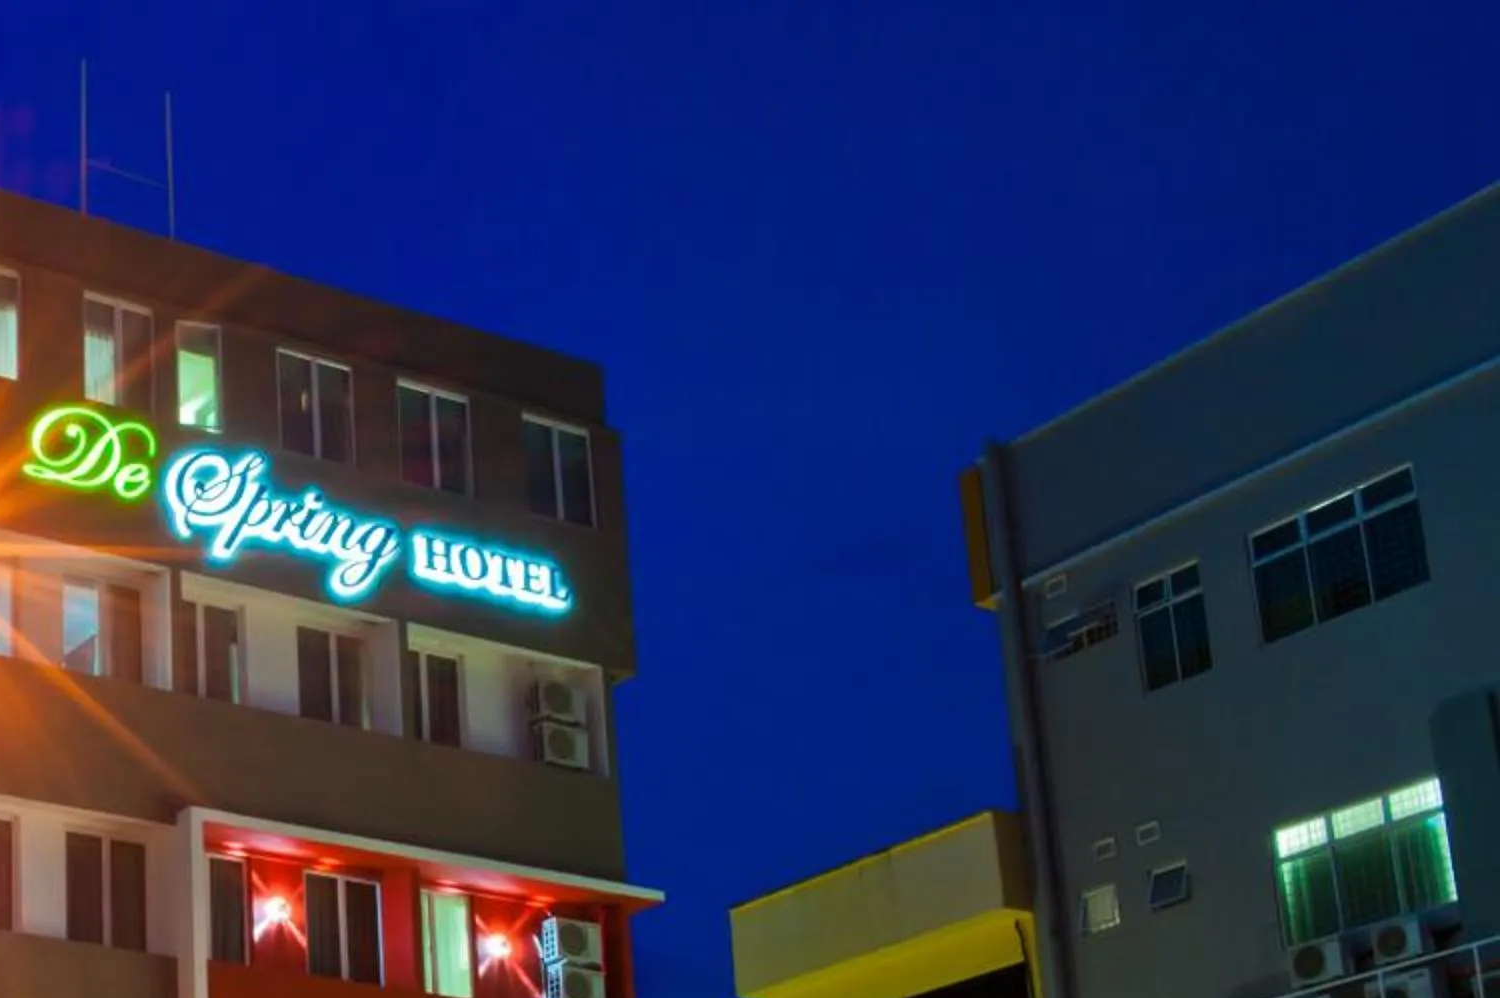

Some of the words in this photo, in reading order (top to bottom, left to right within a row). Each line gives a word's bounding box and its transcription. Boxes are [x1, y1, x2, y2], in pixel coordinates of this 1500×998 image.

[22, 406, 156, 499] De
[165, 448, 401, 595] Spring
[412, 533, 572, 609] HOTEL
